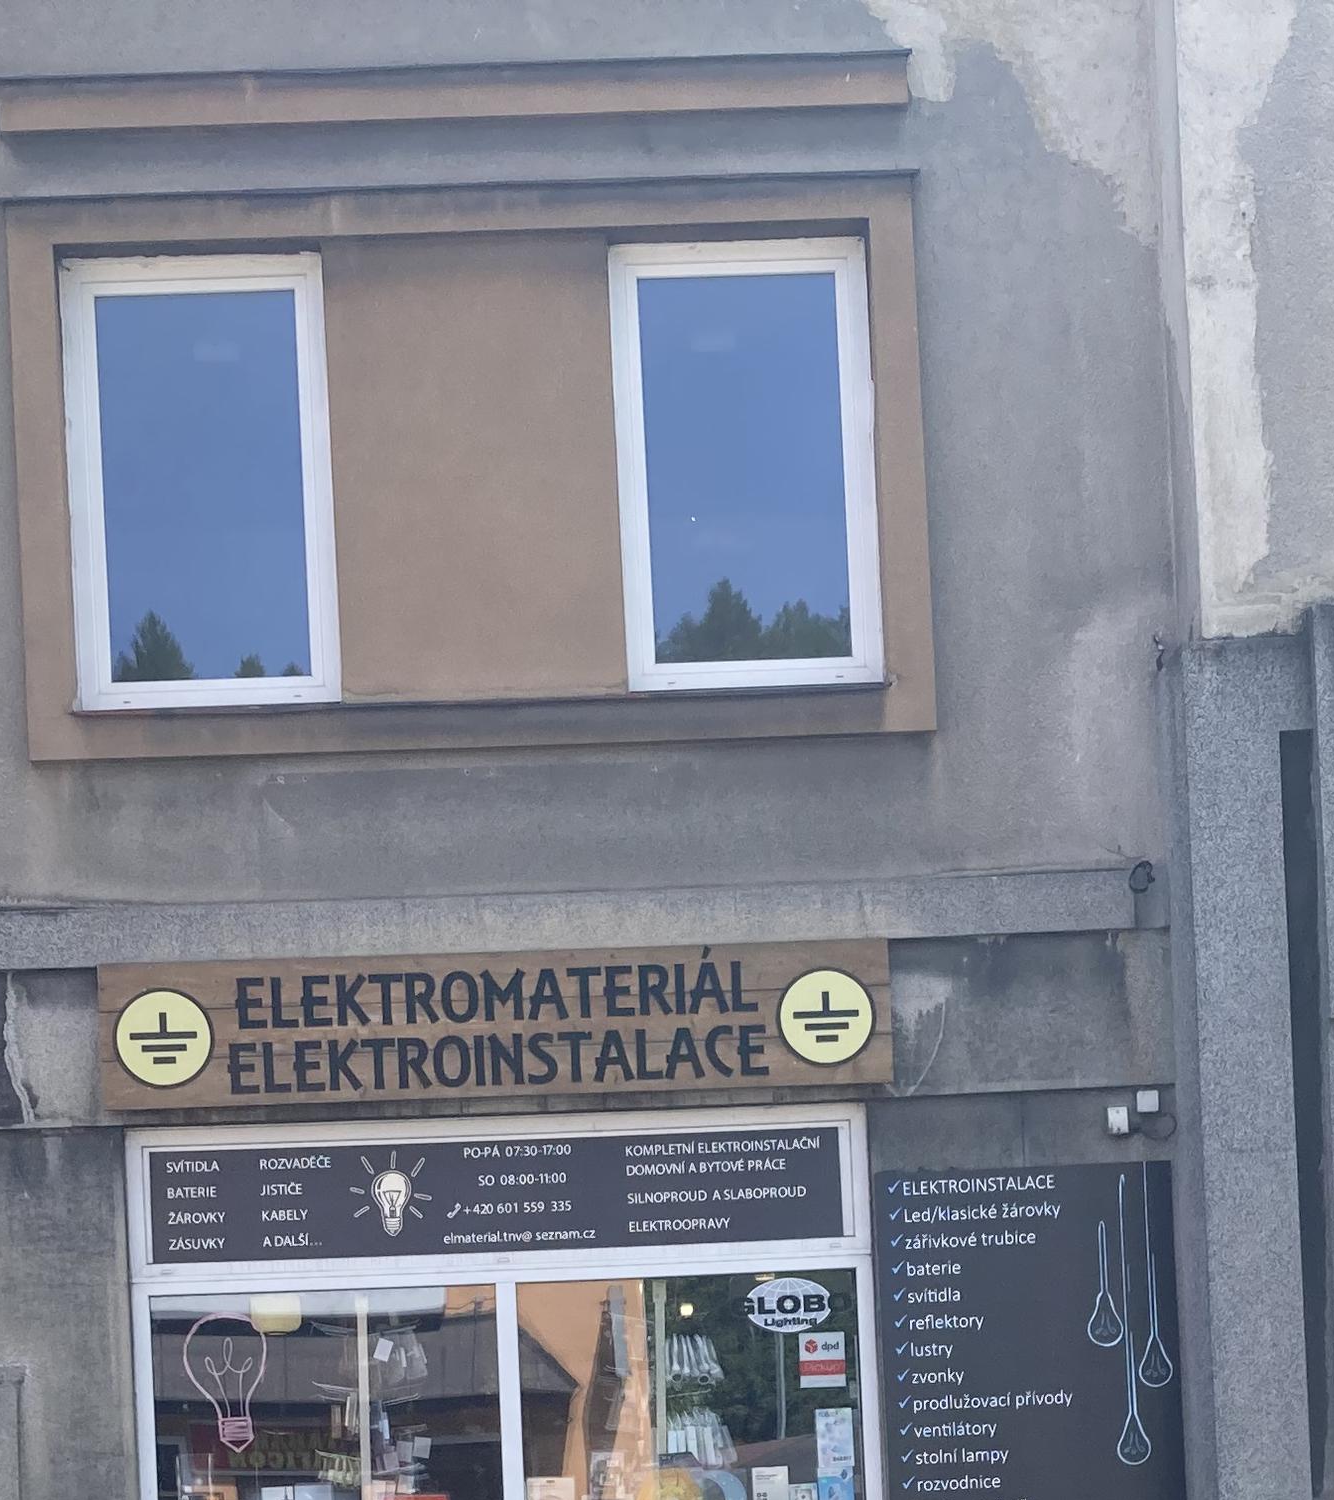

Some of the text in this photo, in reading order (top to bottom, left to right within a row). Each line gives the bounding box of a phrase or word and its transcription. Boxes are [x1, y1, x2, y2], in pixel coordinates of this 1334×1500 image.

[234, 946, 760, 1031] ELEKTROMATERIÁL
[227, 1023, 770, 1095] ELEKTROINSTALACE
[463, 1143, 572, 1159] PO-PÁ 07:30-17:00
[625, 1136, 820, 1157] KOMPLETNÍ ELEKTROINSTALAČNÍ
[166, 1159, 219, 1173] SVÍTIDLA
[260, 1156, 331, 1171] ROZVADĚČE
[626, 1157, 786, 1176] DOMOVNÍ A BYTOVÉ PRÁCE
[478, 1172, 567, 1187] SO 08:00-11:00
[902, 1174, 1055, 1196] ELEKTROINSTALACE
[167, 1186, 217, 1199] BATERIE
[260, 1182, 303, 1197] JISTIČE
[627, 1185, 807, 1204] SILNOPROUD A SLABOPROUD
[262, 1208, 308, 1222] KABELY
[463, 1199, 572, 1216] +420 601 559 335
[903, 1201, 1061, 1224] Led/klasické žárovky
[168, 1210, 225, 1225] ŽÁROVKY
[628, 1216, 730, 1233] ELEKTROOPRAVY
[263, 1236, 272, 1248] A
[535, 1228, 595, 1241] seznam.cz
[905, 1230, 1036, 1250] zářivkové trubice
[169, 1236, 225, 1251] ZÁSUVKY
[906, 1261, 961, 1277] baterie
[907, 1287, 961, 1304] svítidla
[764, 1317, 817, 1327] Lighting
[909, 1314, 984, 1332] reflektory
[821, 1341, 839, 1352] dpd
[910, 1342, 953, 1359] lustry
[911, 1369, 964, 1386] zvonky
[913, 1389, 1073, 1414] prodlužovací přívody
[914, 1420, 997, 1438] ventilátory
[916, 1447, 1009, 1465] stolní lampy
[917, 1475, 1001, 1492] rozvodnice
